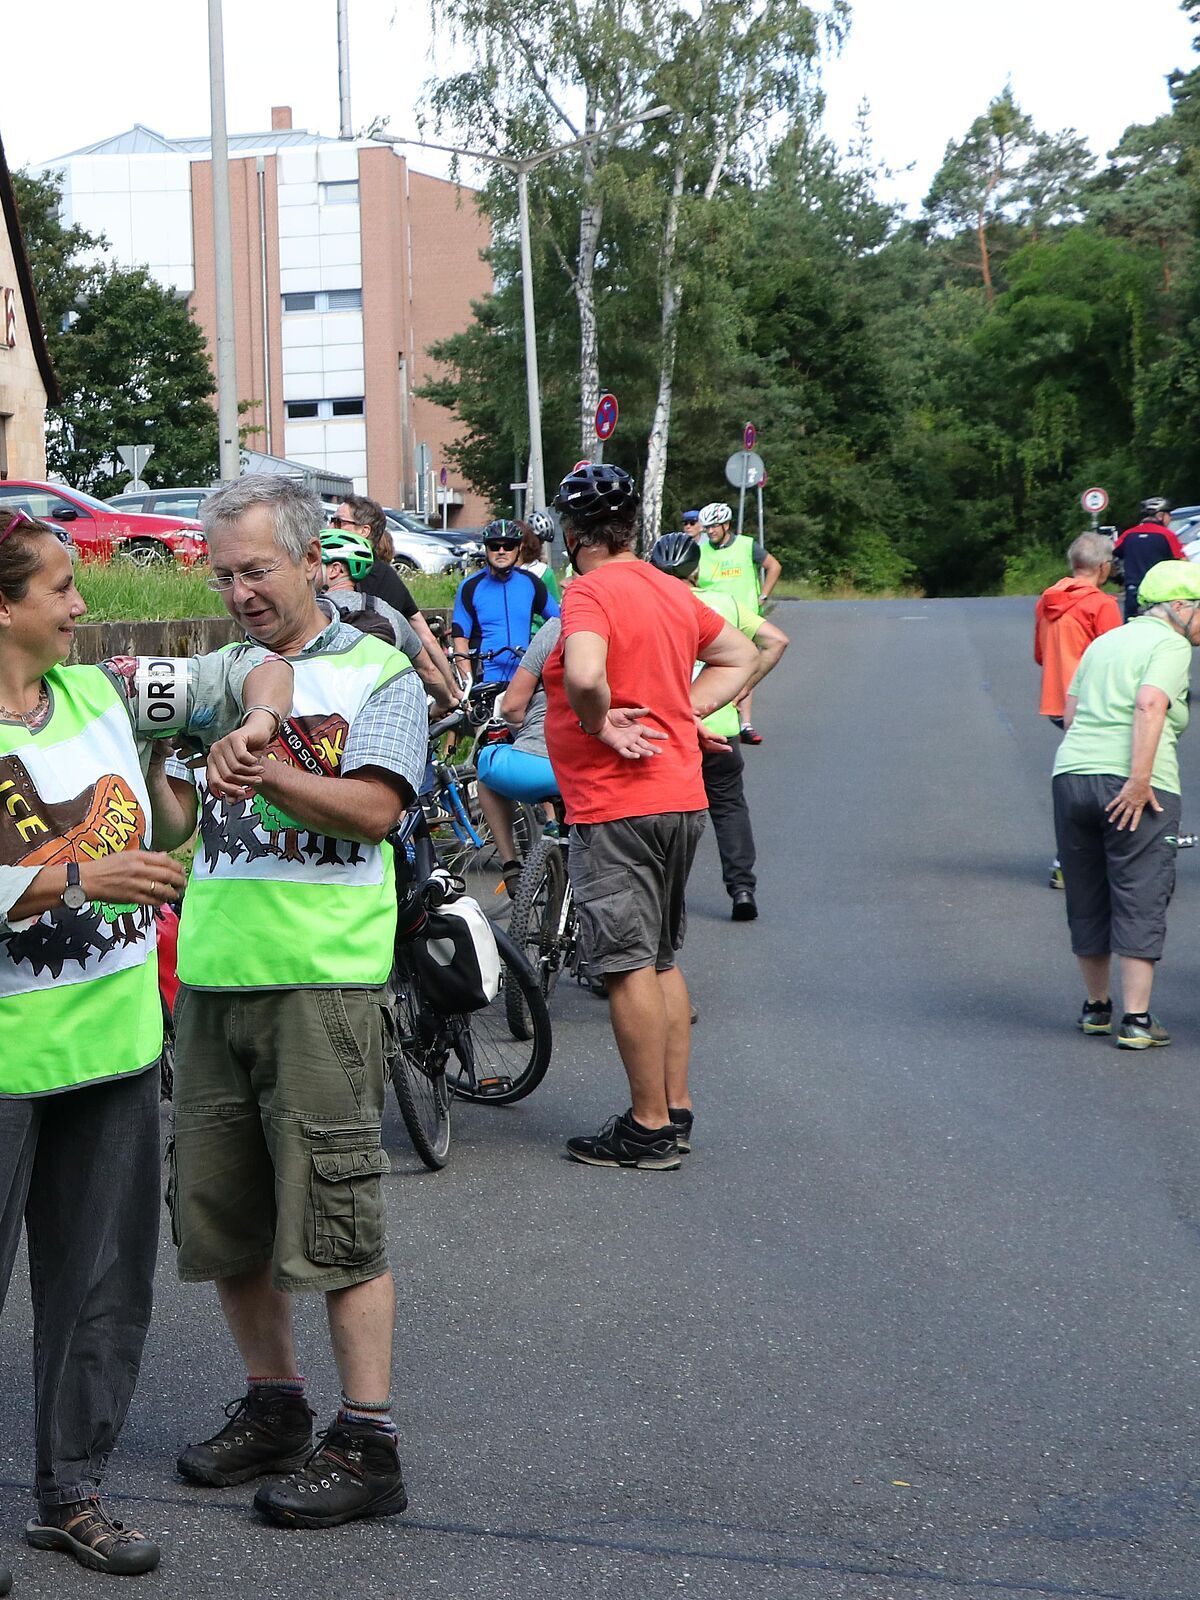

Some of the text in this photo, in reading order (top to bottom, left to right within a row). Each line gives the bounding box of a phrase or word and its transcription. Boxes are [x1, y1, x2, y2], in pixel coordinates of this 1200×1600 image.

[147, 657, 176, 722] ORD
[287, 734, 303, 750] 6D
[298, 750, 324, 776] EOS
[79, 783, 139, 861] WERK
